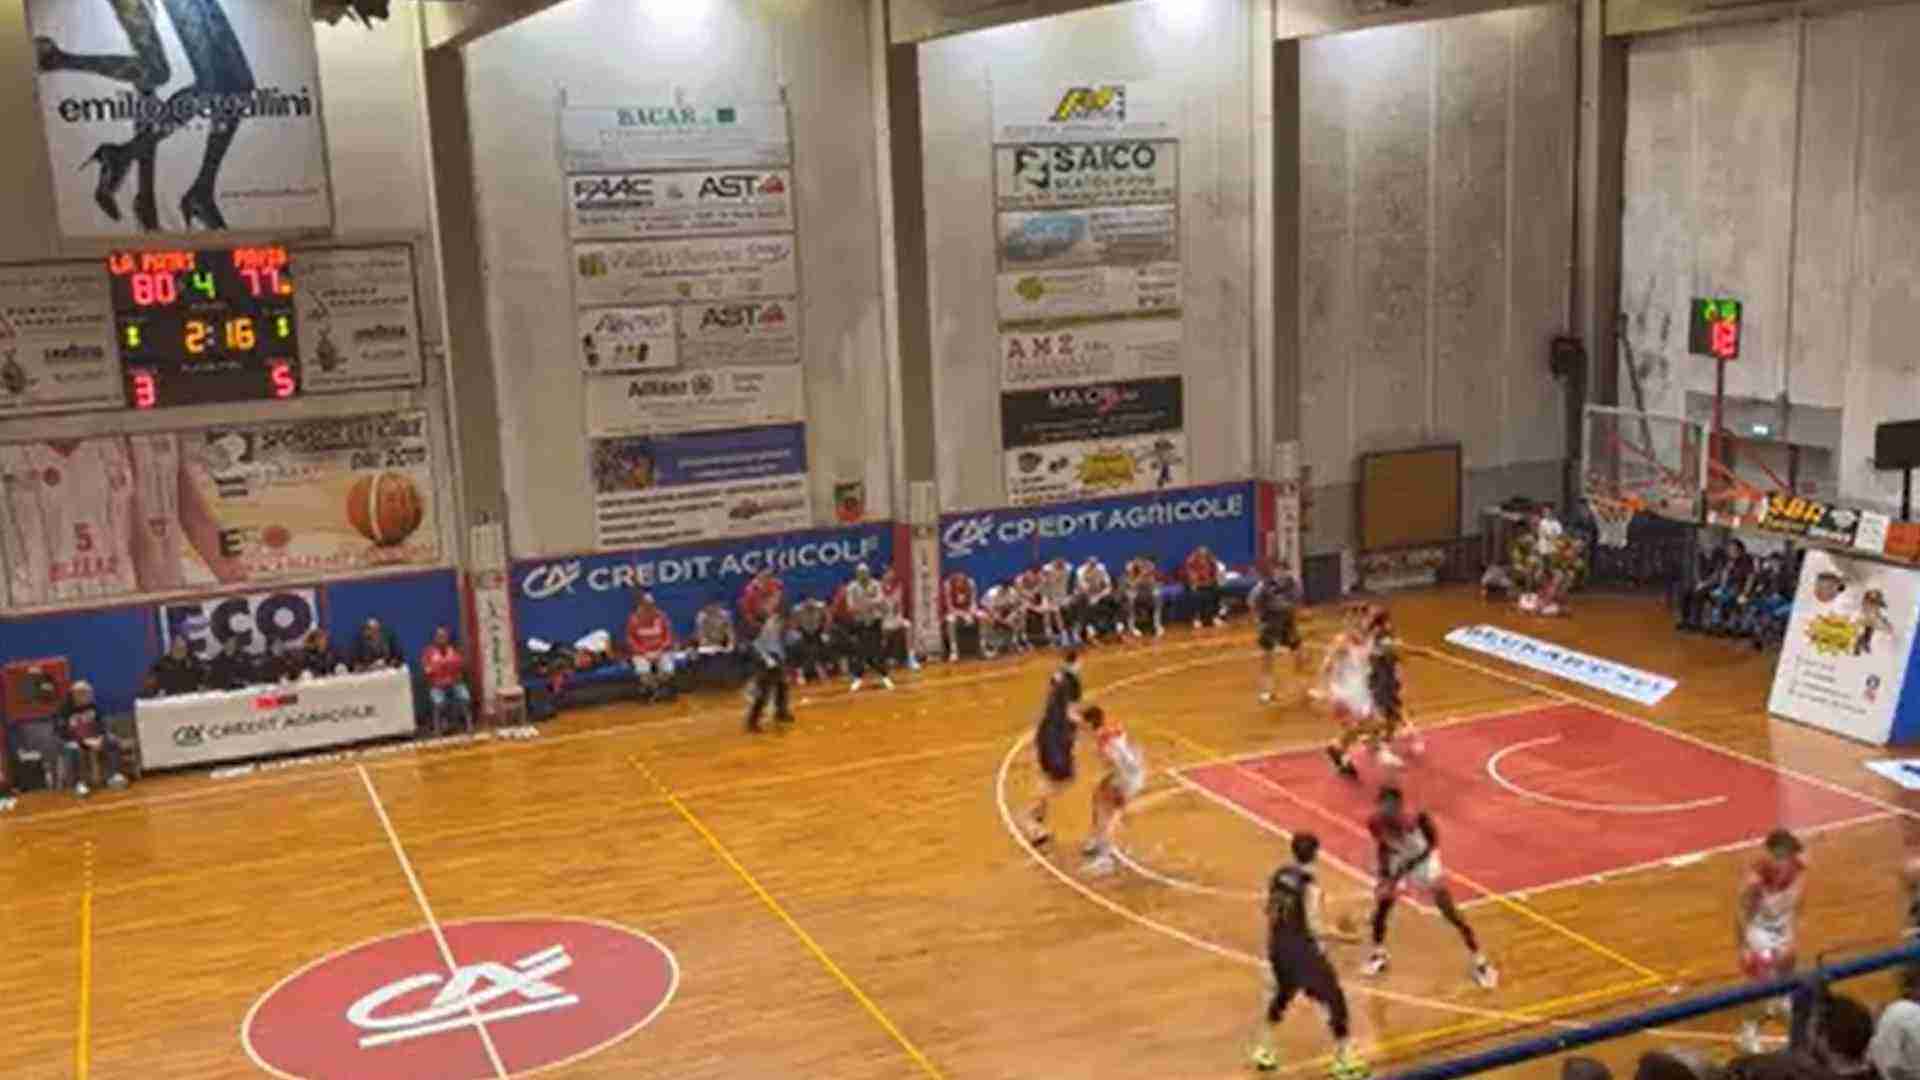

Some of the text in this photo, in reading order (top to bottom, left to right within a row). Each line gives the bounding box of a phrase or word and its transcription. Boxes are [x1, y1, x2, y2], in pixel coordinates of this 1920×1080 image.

[1054, 145, 1157, 172] SAICO
[699, 176, 760, 198] AST
[131, 272, 177, 305] 80
[192, 271, 217, 300] 4
[184, 317, 256, 353] 2:16
[134, 374, 155, 406] 3
[271, 363, 295, 397] 5
[587, 555, 713, 591] CREDIT
